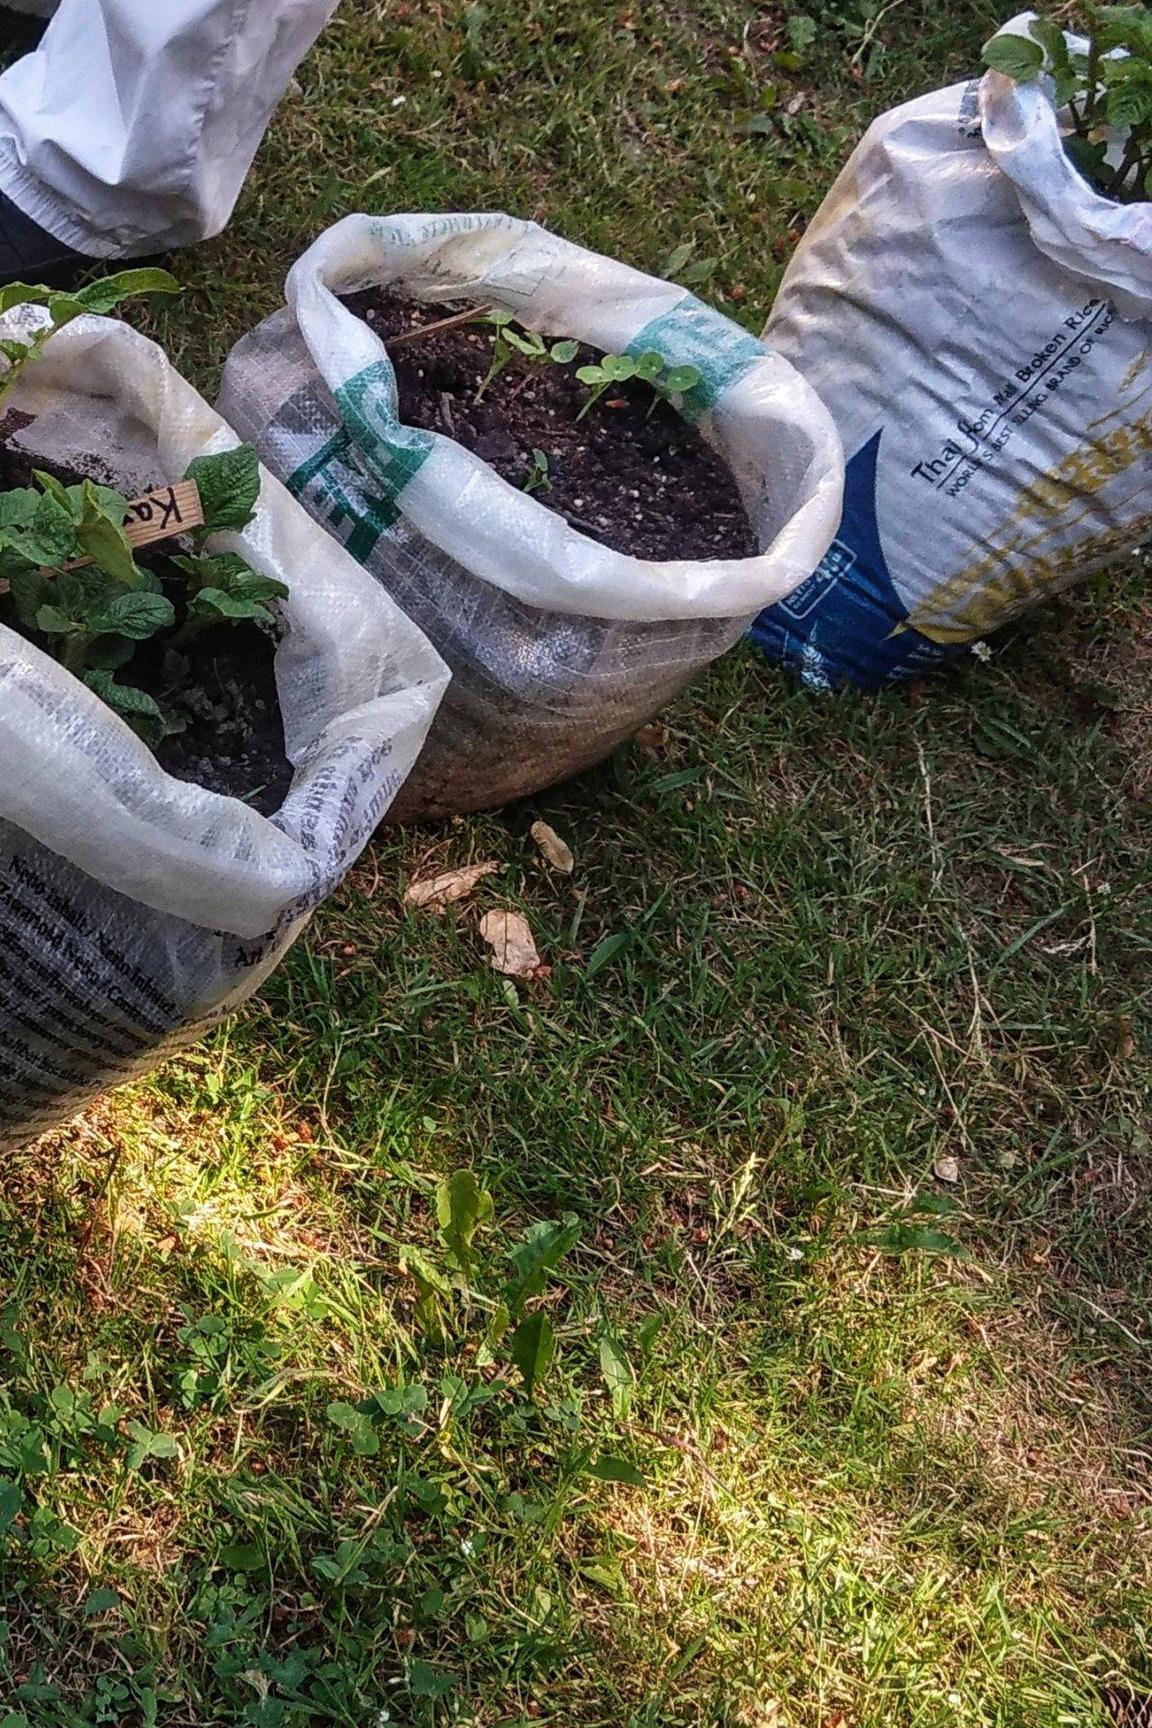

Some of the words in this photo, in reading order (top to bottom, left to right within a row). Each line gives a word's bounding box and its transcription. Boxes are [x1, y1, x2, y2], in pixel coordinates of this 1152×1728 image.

[909, 437, 964, 486] Thai
[1015, 331, 1067, 384] Broken
[1064, 296, 1101, 331] Rice
[989, 424, 1016, 453] BEST
[1045, 354, 1082, 393] BRAND
